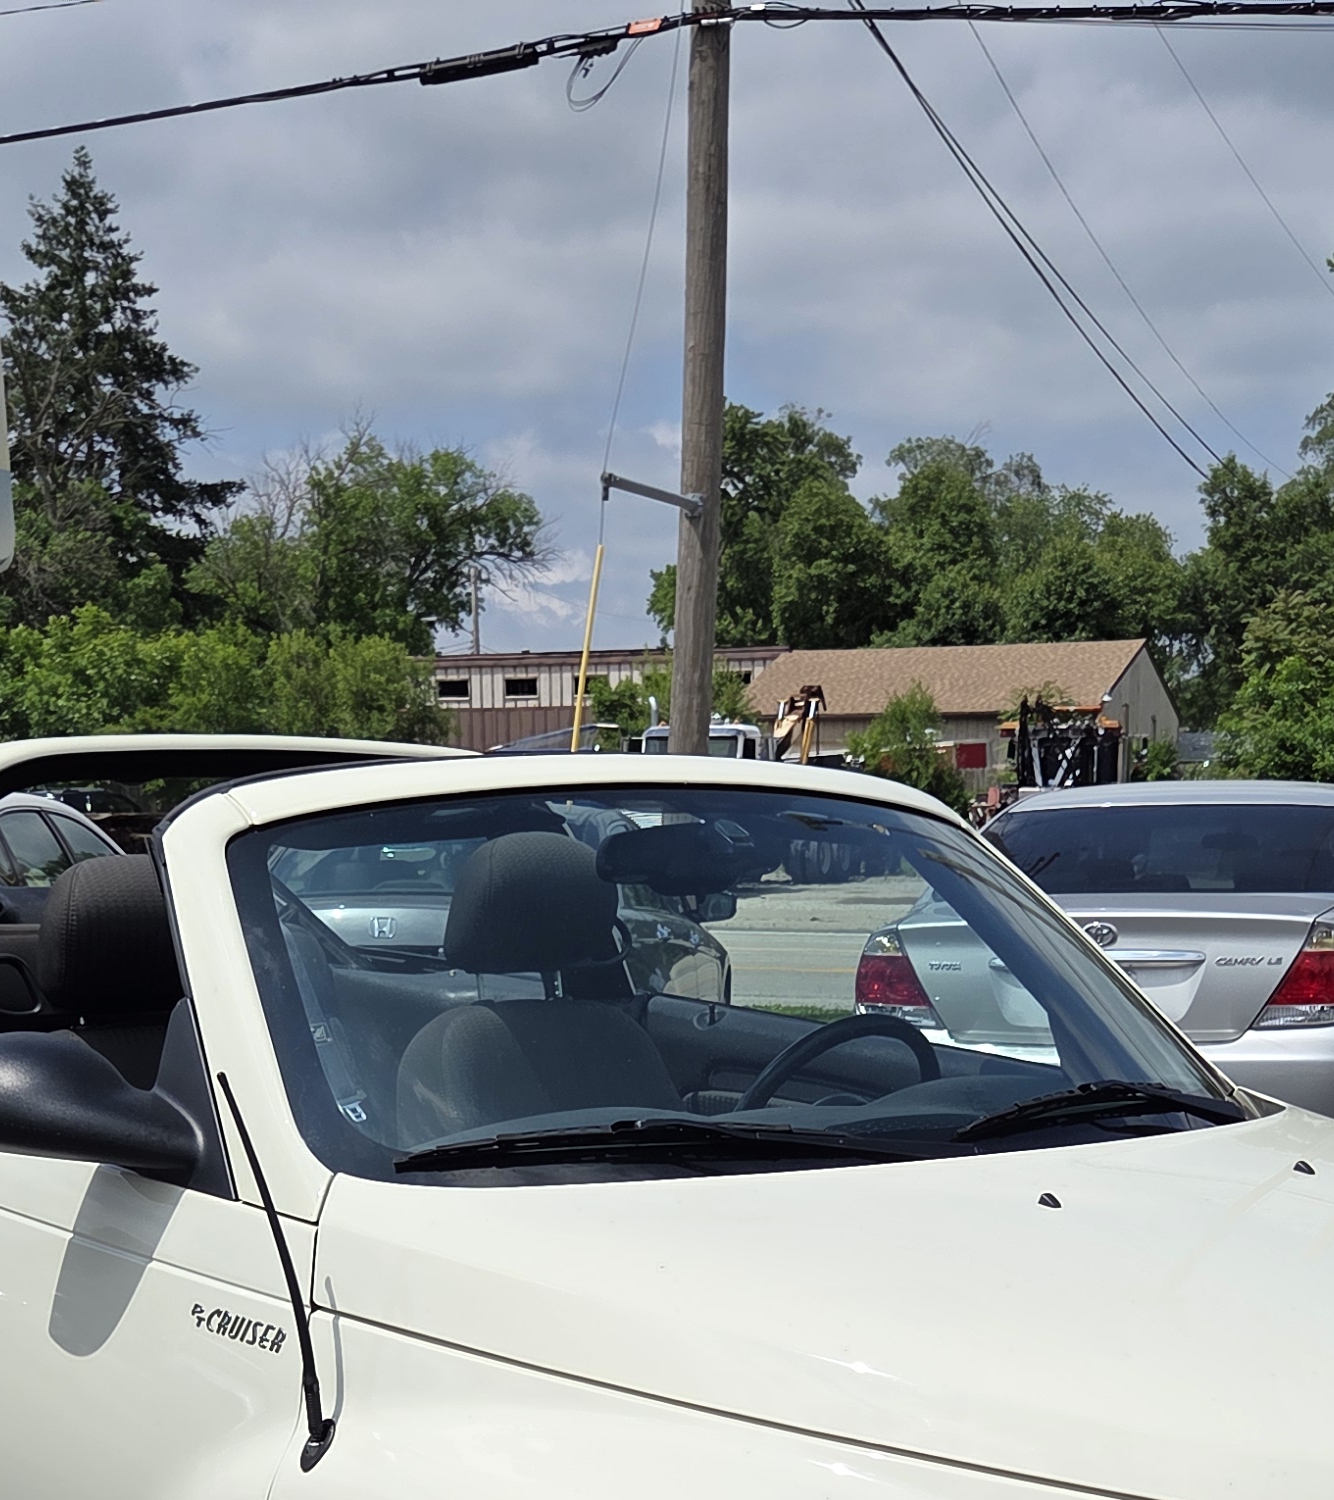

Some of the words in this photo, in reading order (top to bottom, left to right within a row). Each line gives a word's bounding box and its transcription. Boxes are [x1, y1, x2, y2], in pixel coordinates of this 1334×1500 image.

[1214, 955, 1265, 966] CAMRY
[1267, 957, 1283, 966] LE
[206, 1308, 287, 1354] CRUISER
